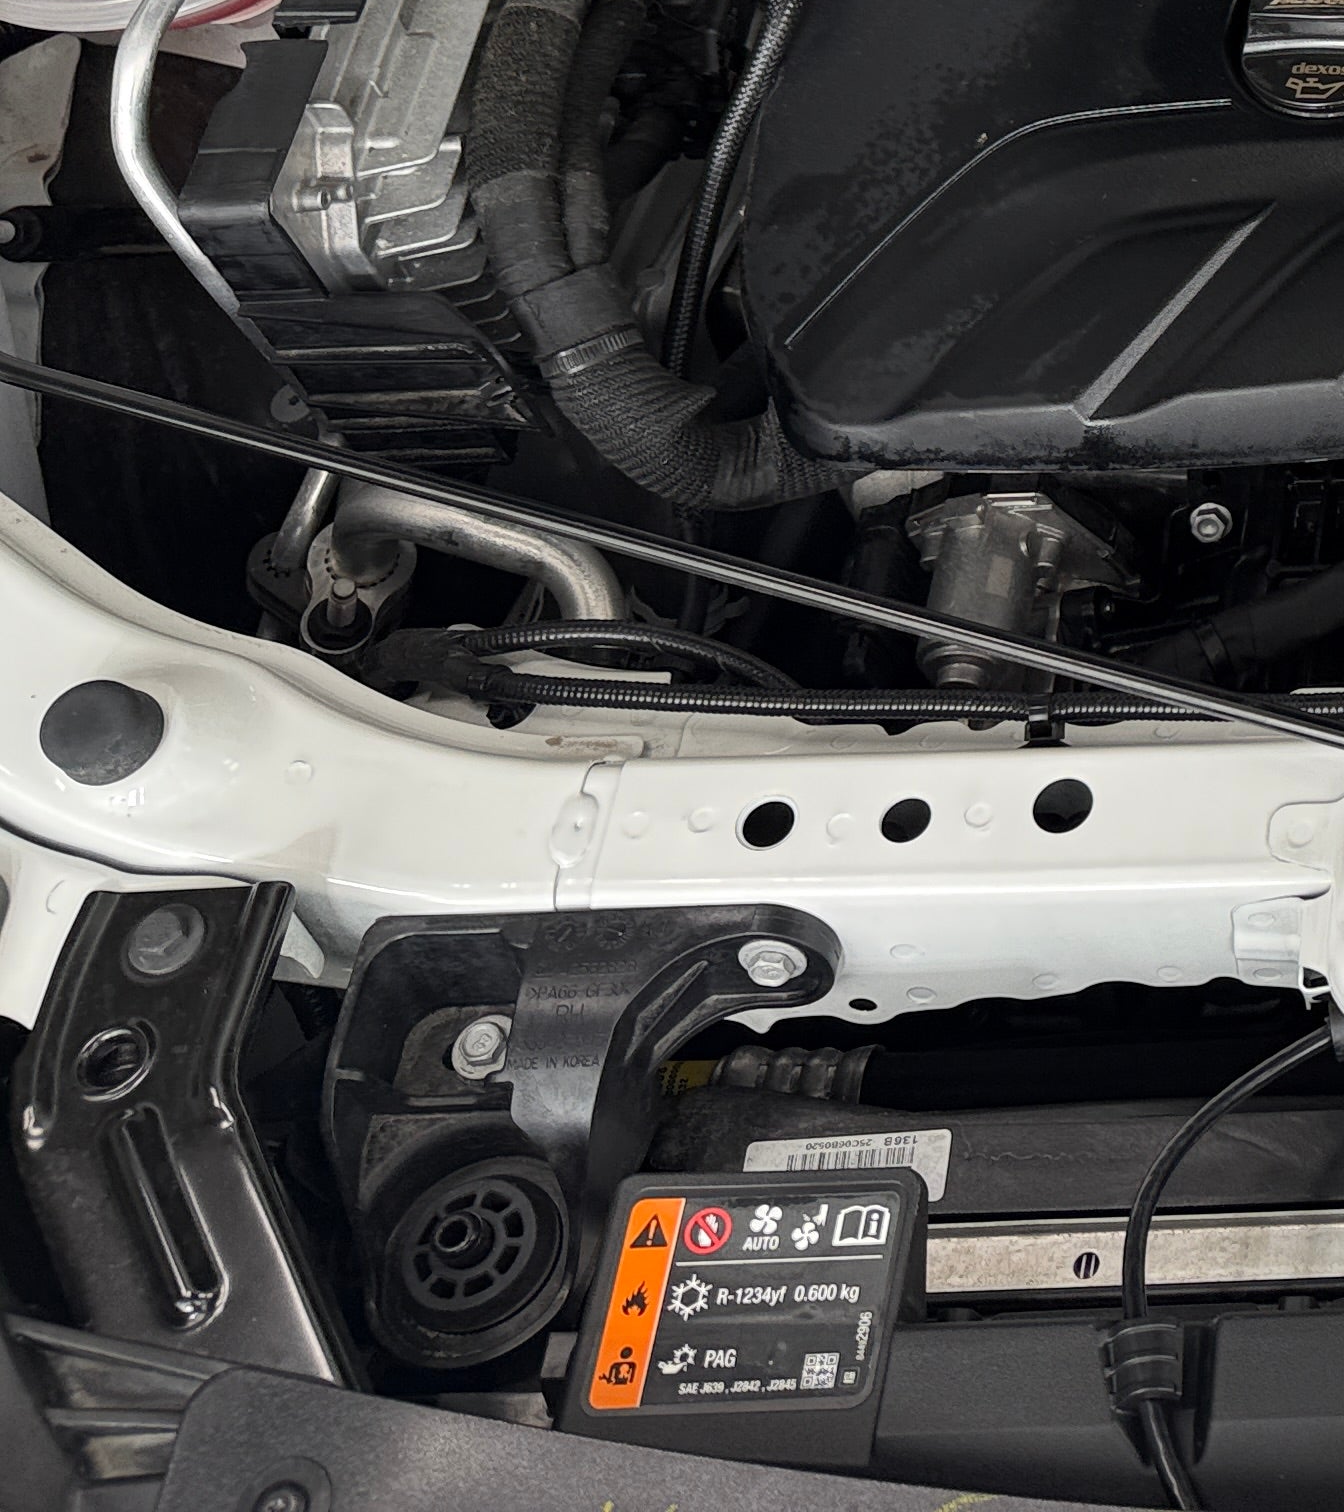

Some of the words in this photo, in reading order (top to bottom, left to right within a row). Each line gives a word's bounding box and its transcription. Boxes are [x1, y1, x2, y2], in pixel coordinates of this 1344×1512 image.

[506, 1056, 539, 1071] MADE
[545, 1055, 559, 1069] IN
[562, 1053, 601, 1068] KOREA
[742, 1236, 780, 1251] AUTO
[716, 1285, 788, 1307] R-1234yf
[793, 1284, 838, 1303] 0.600
[839, 1283, 861, 1304] kg
[703, 1348, 738, 1369] PAG
[678, 1382, 699, 1395] SAE
